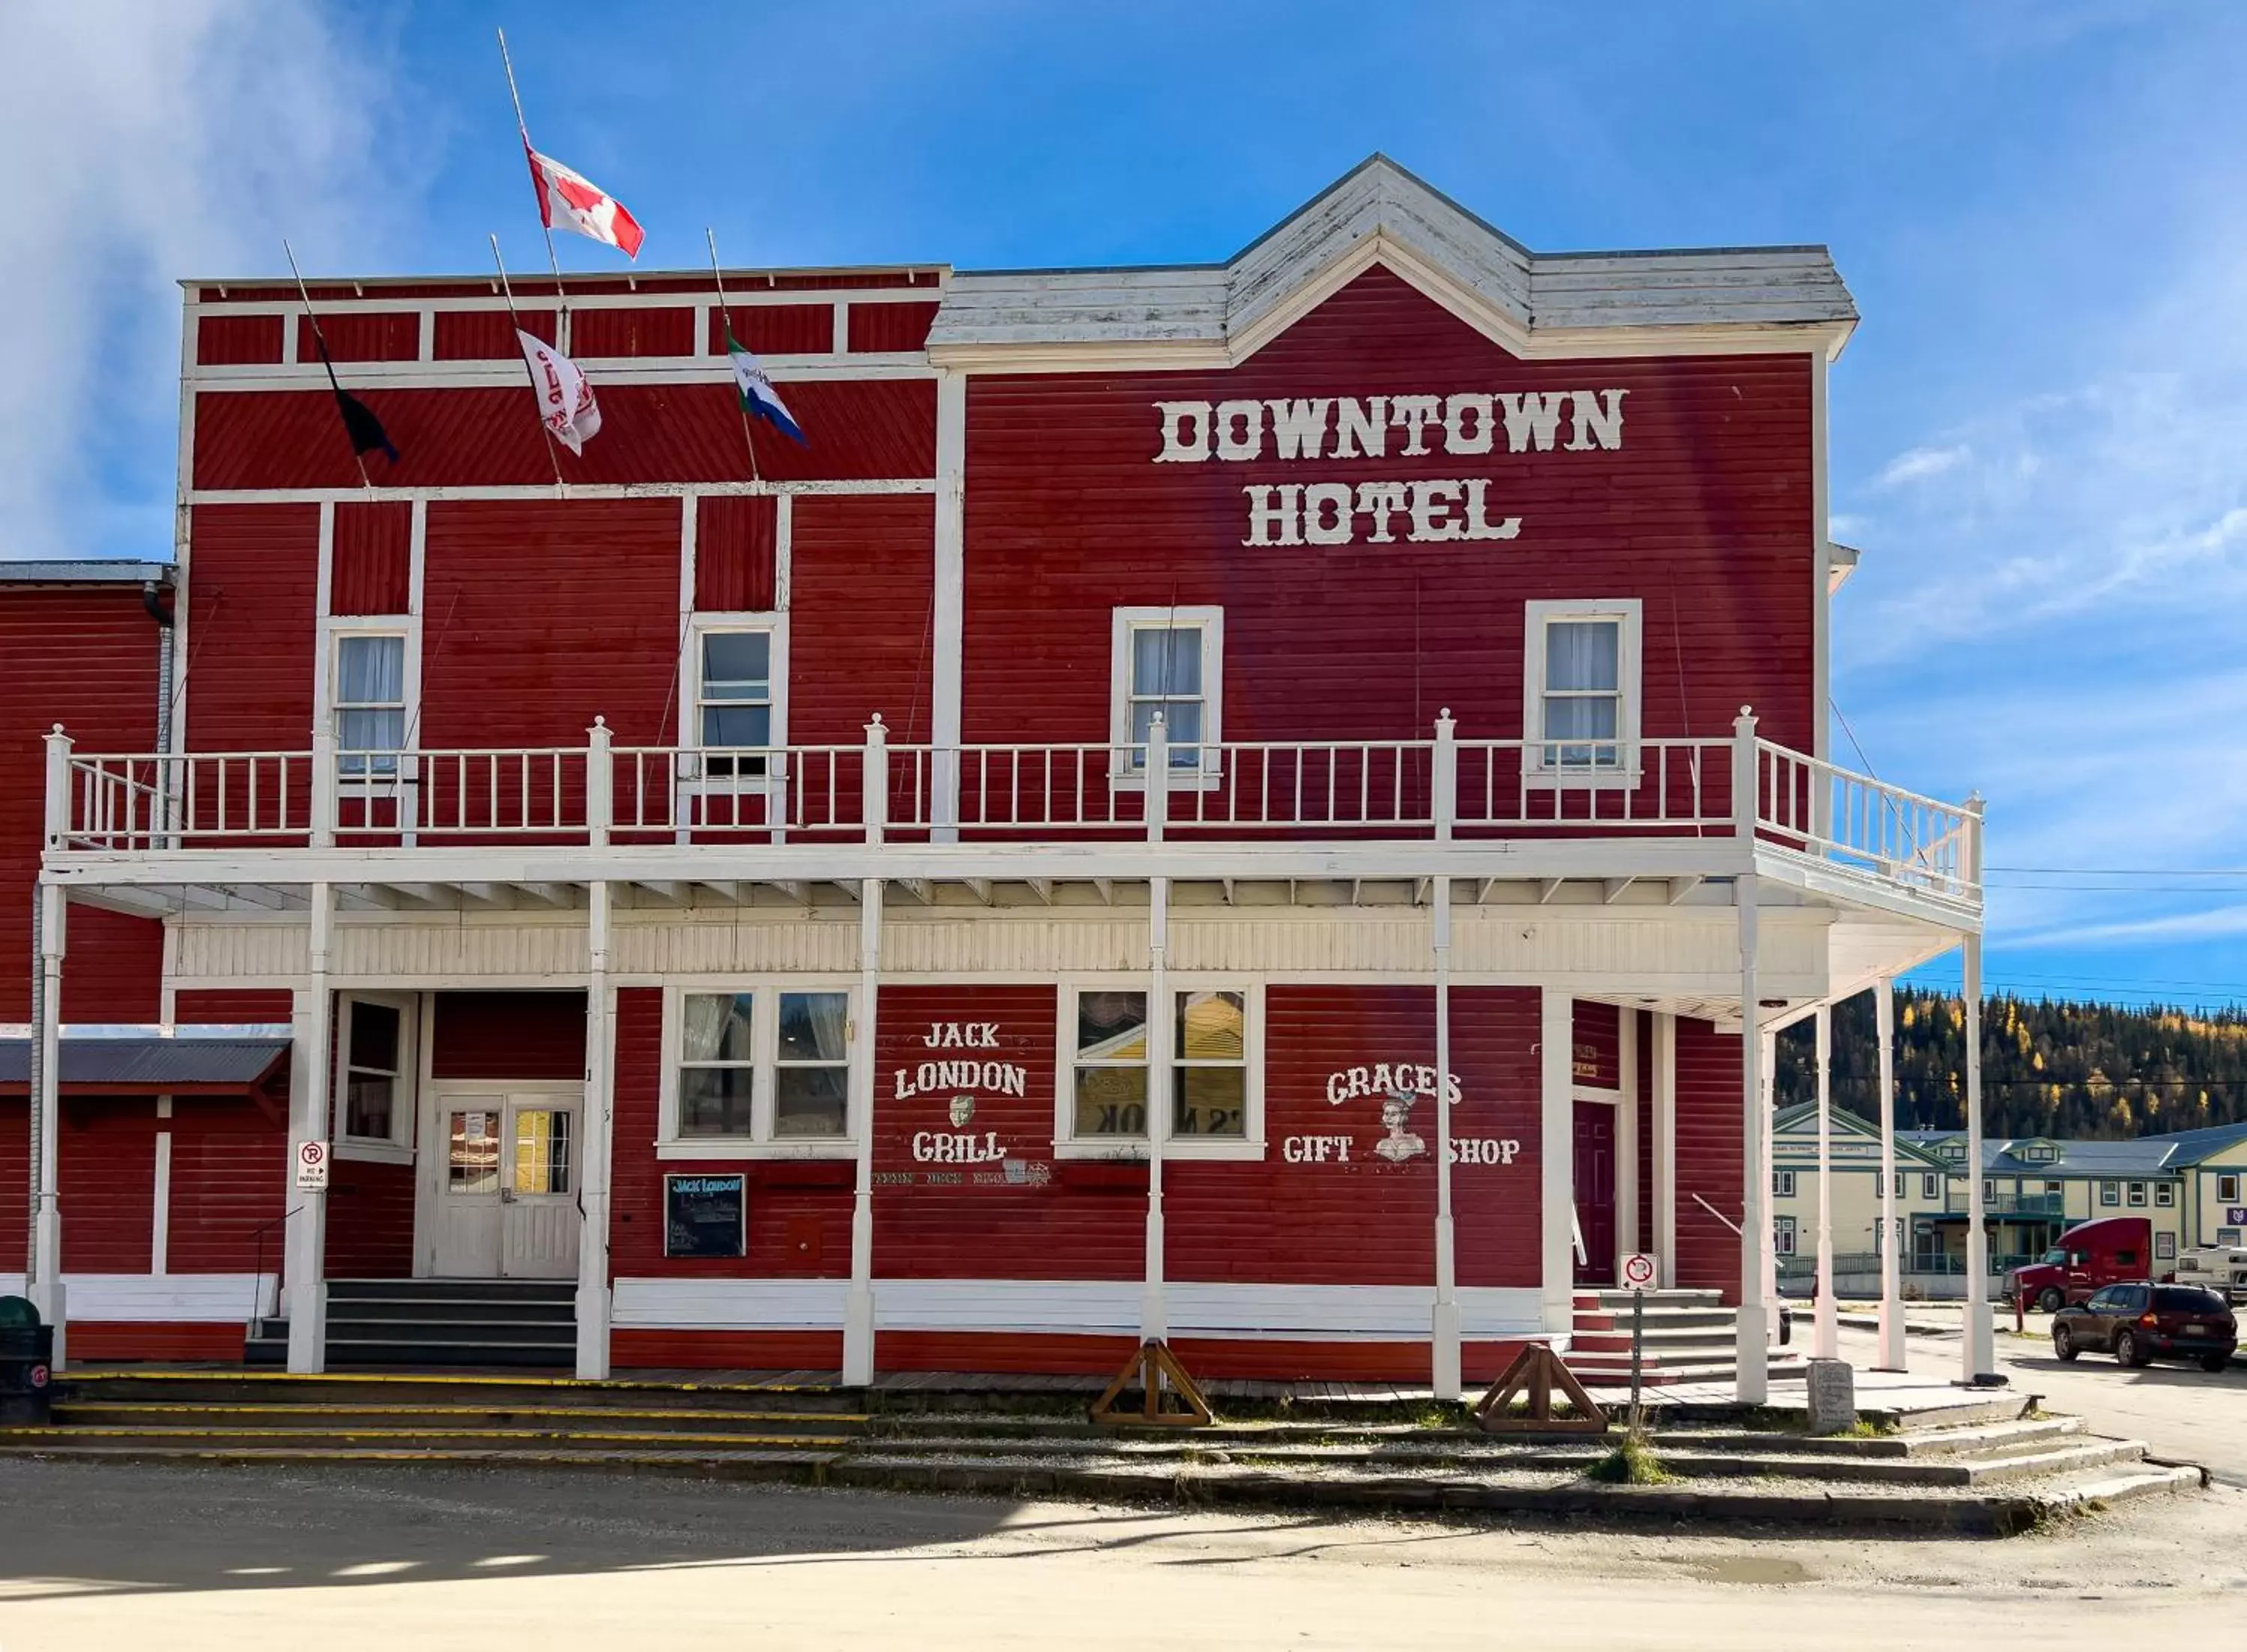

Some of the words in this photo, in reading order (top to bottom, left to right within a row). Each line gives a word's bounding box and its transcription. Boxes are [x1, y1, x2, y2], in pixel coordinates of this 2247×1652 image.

[1152, 389, 1630, 463] DOWNTOWN
[1242, 479, 1522, 546] HOTEL
[923, 1023, 999, 1047] JACK
[895, 1061, 1026, 1099] LONDON
[913, 1132, 1007, 1162] GRILL
[1283, 1136, 1353, 1162] GIFT
